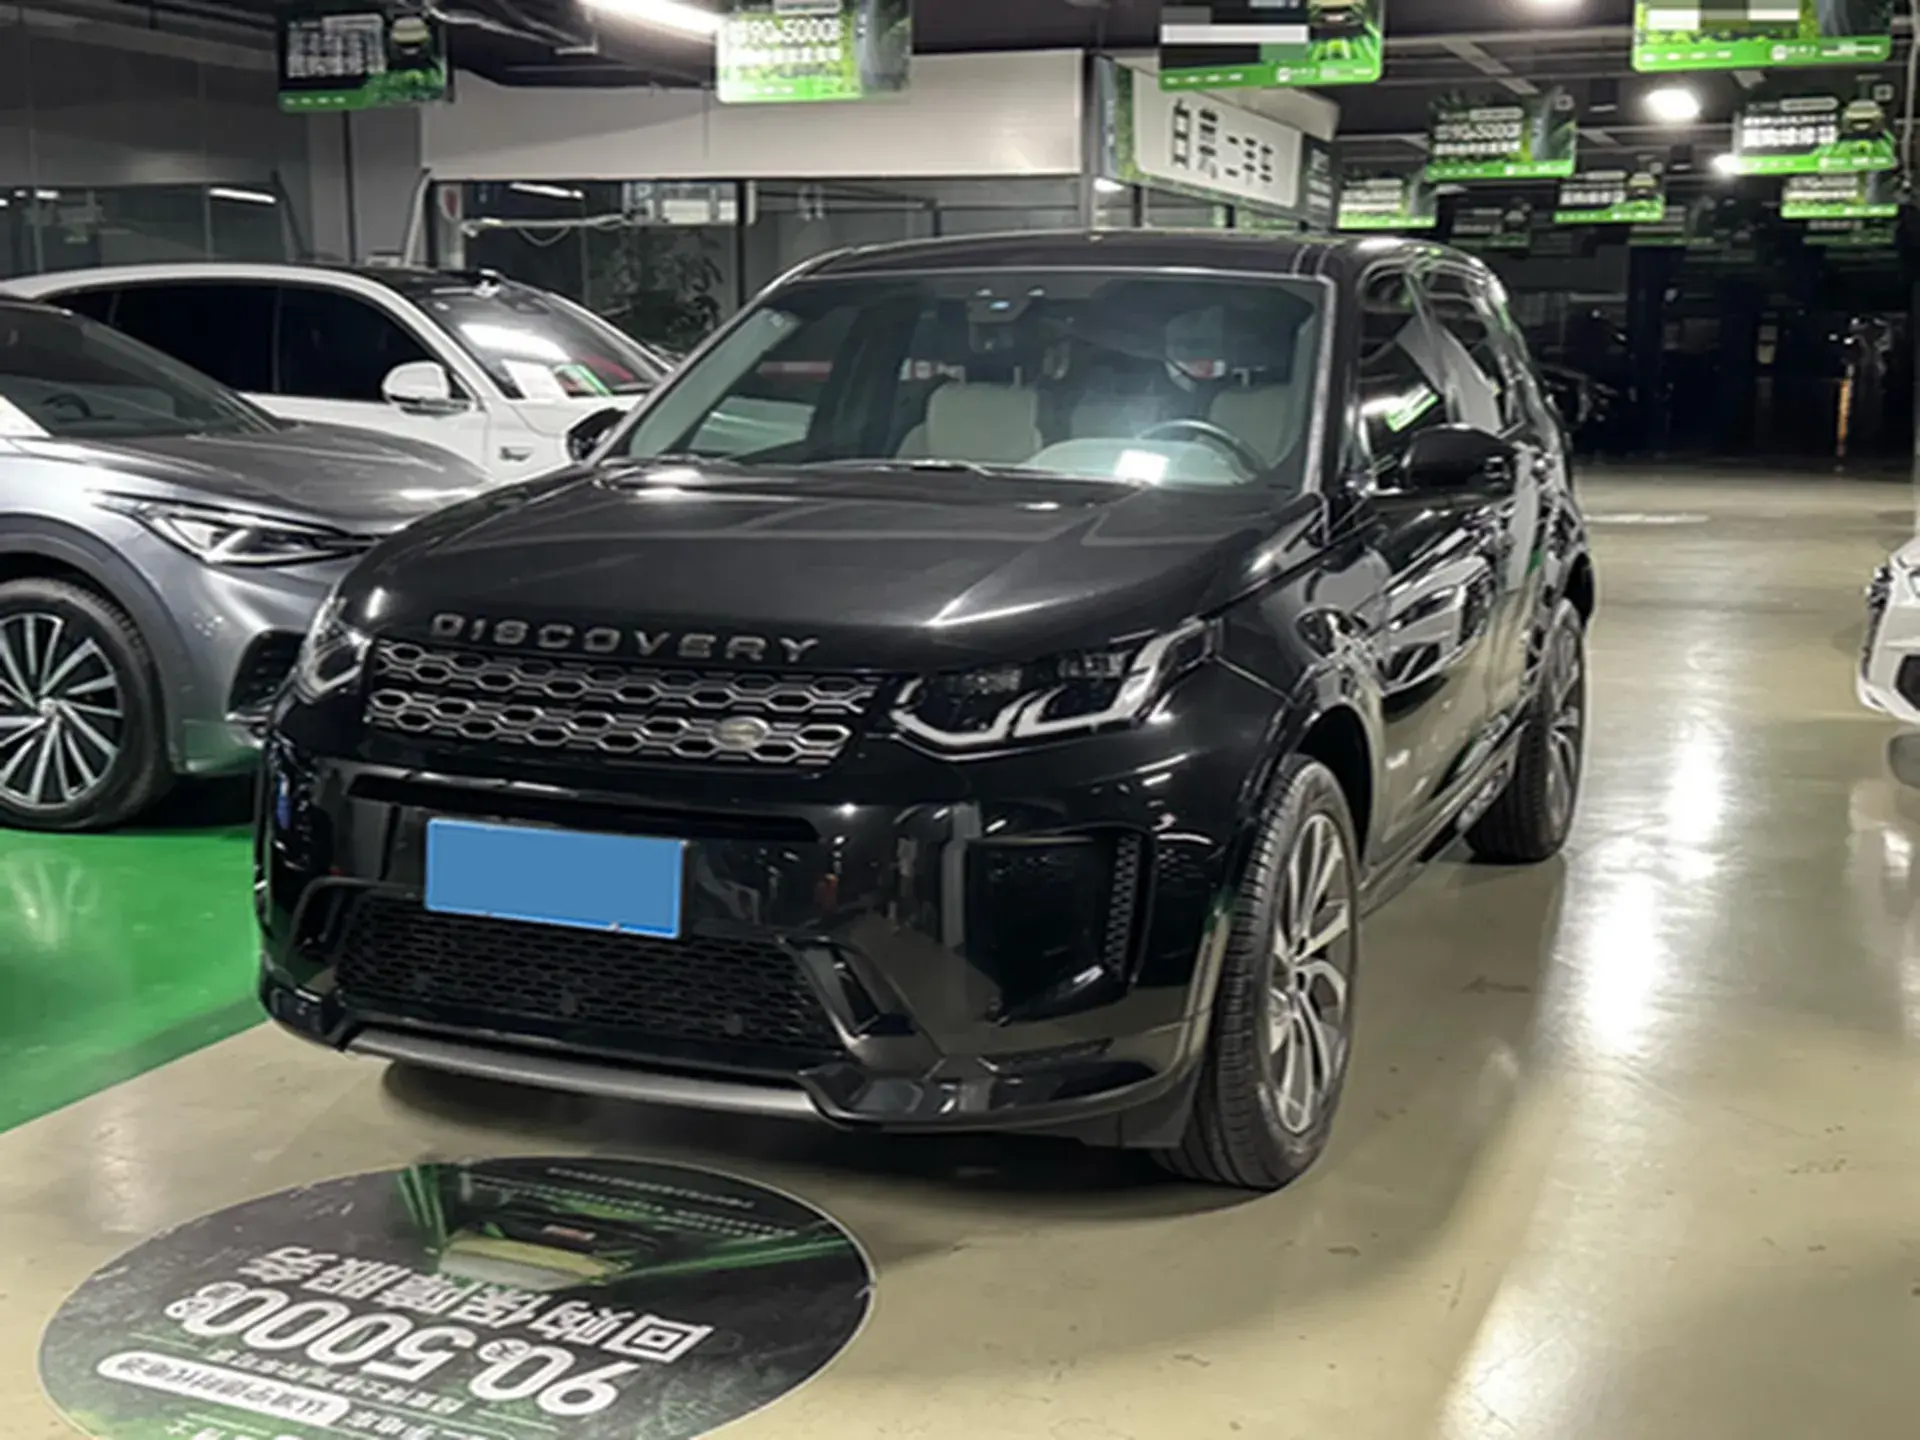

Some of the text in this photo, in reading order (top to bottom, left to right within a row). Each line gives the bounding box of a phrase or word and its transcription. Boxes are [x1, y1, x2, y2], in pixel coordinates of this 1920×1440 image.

[430, 611, 821, 664] DISCOVERY
[235, 1245, 715, 1362] 回购保障服务
